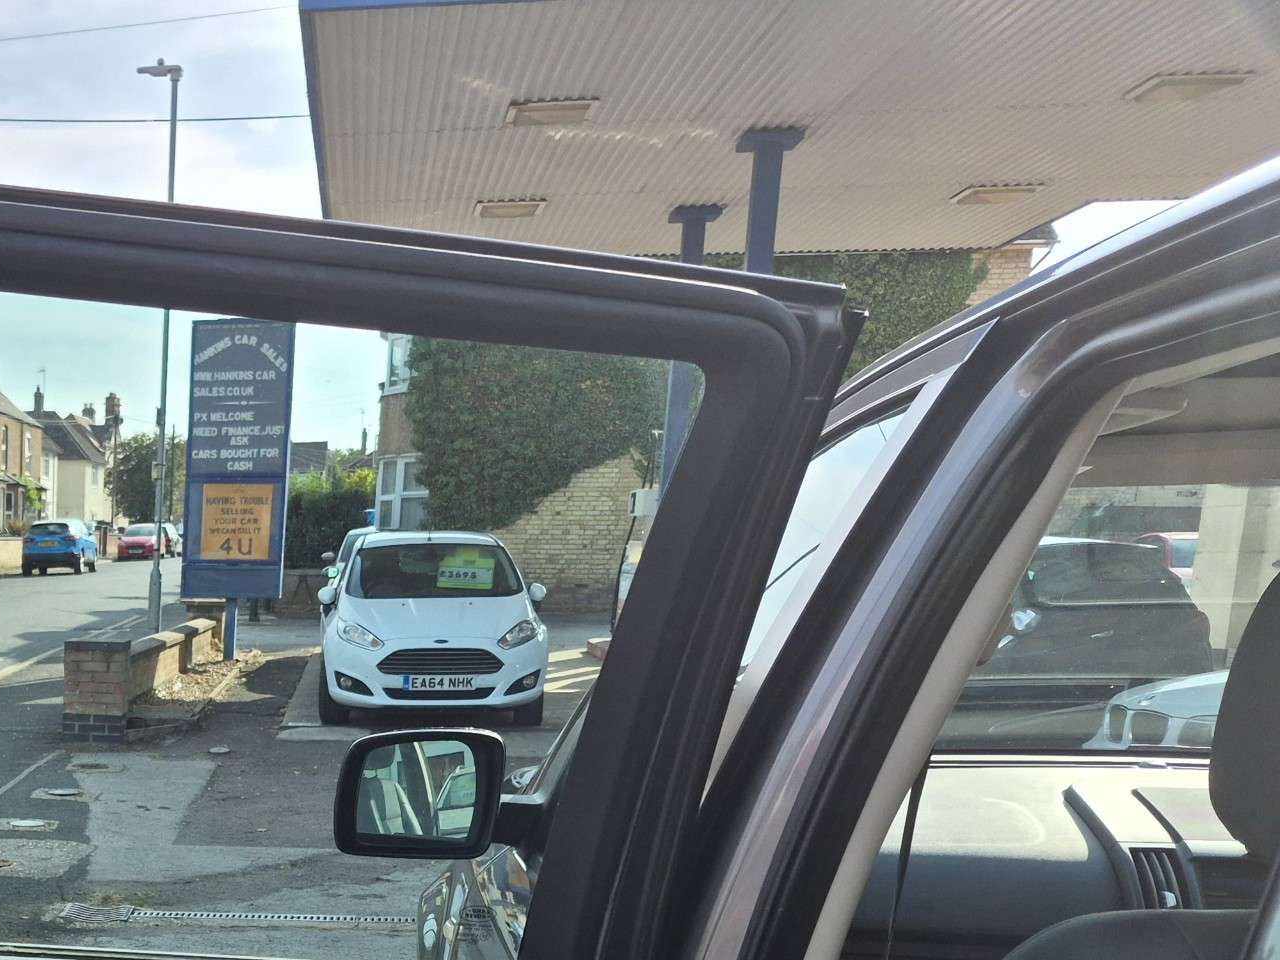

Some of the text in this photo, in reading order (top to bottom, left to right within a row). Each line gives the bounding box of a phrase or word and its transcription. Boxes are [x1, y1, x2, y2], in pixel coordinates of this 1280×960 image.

[194, 334, 287, 372] HANKINS CAR SALES
[255, 370, 276, 380] CAR
[193, 411, 255, 422] PX WELCOME
[192, 427, 217, 437] NEED
[230, 436, 249, 446] ASK
[192, 448, 279, 459] CARS BOUGHT FOR
[227, 461, 253, 471] CASH
[240, 517, 258, 525] CAR
[219, 537, 253, 555] 4 U
[411, 677, 473, 688] EA64 NHK
